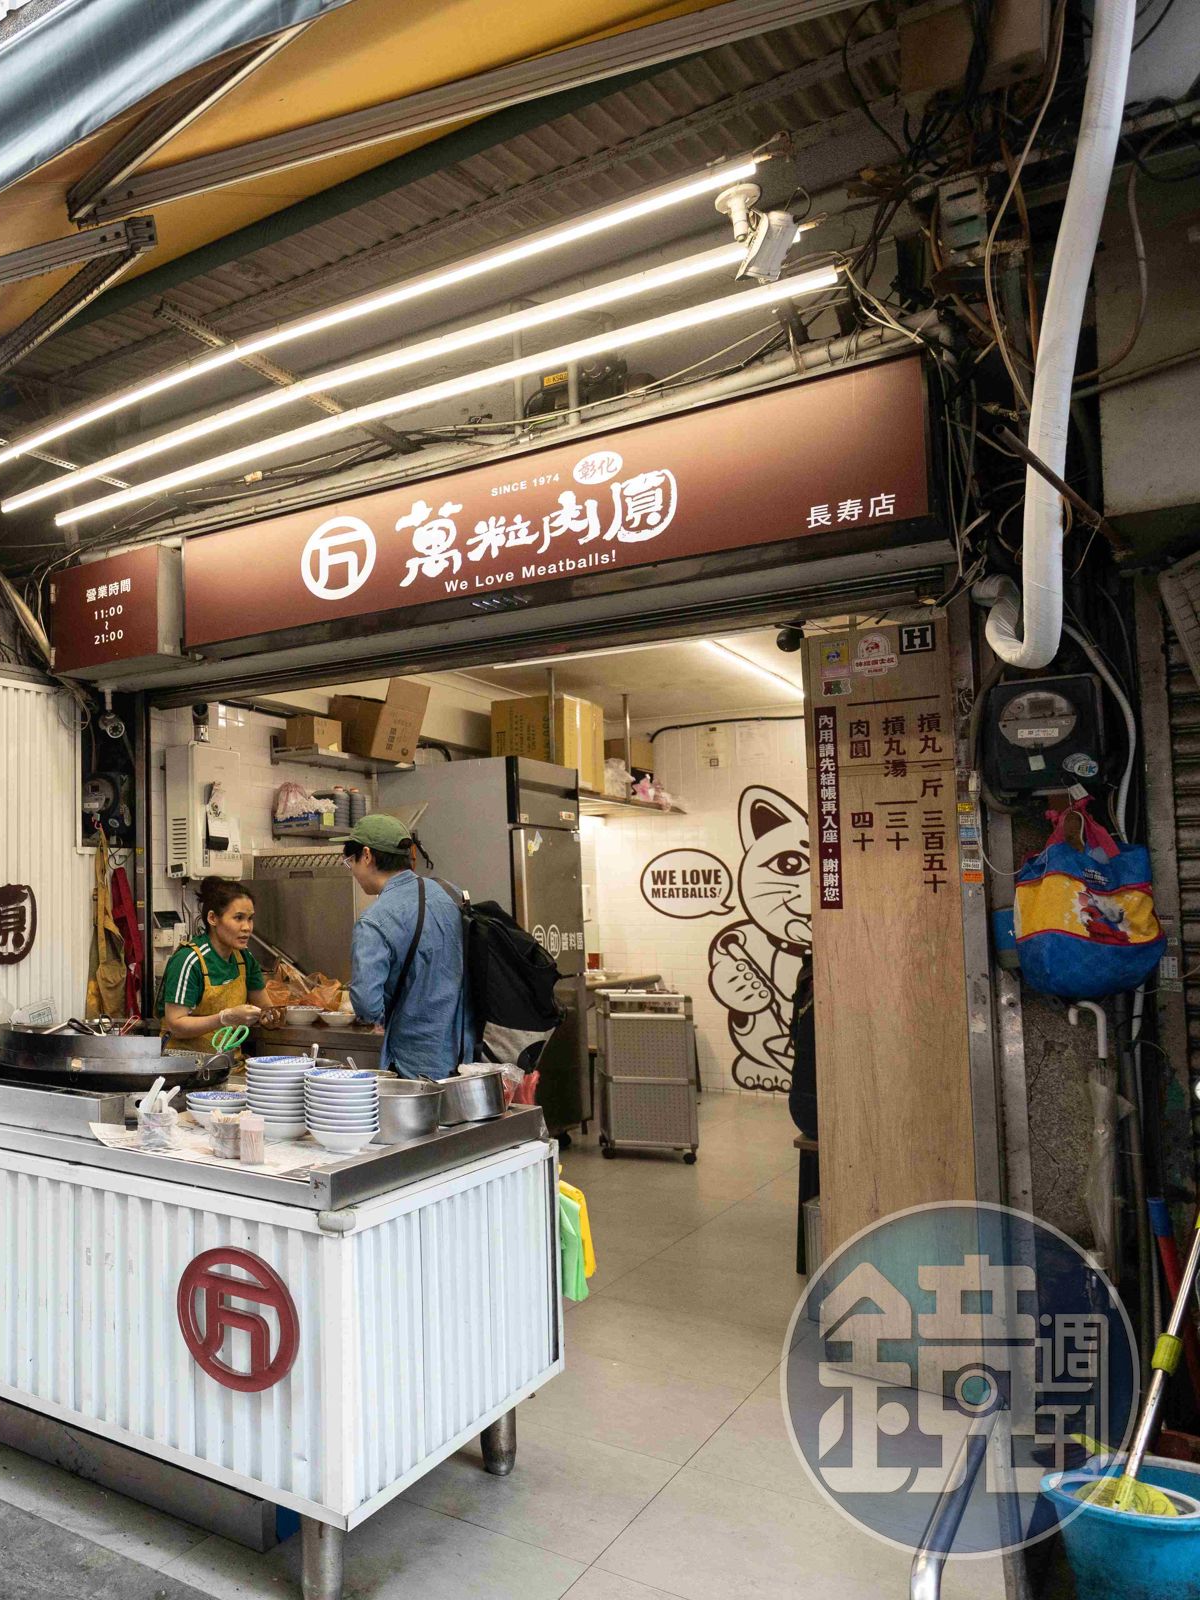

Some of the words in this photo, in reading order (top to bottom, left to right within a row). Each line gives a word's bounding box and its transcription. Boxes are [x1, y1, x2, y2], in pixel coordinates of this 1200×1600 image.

[577, 457, 620, 481] 彰化
[491, 481, 528, 497] SINCE
[532, 474, 560, 487] 1974
[395, 469, 678, 587] 萬粒肉圓
[445, 579, 469, 593] We
[476, 571, 514, 588] Love
[522, 550, 617, 579] Meatballs!
[86, 578, 131, 603] 營業時間
[94, 605, 123, 620] 11:00
[94, 629, 124, 645] 21:00
[848, 719, 871, 760] 肉圓
[850, 811, 875, 852] 四十
[884, 810, 910, 852] 三十
[920, 809, 948, 893] 三百五十
[651, 869, 677, 886] WE
[681, 869, 722, 885] LOVE
[651, 887, 722, 899] MEATBALLS!
